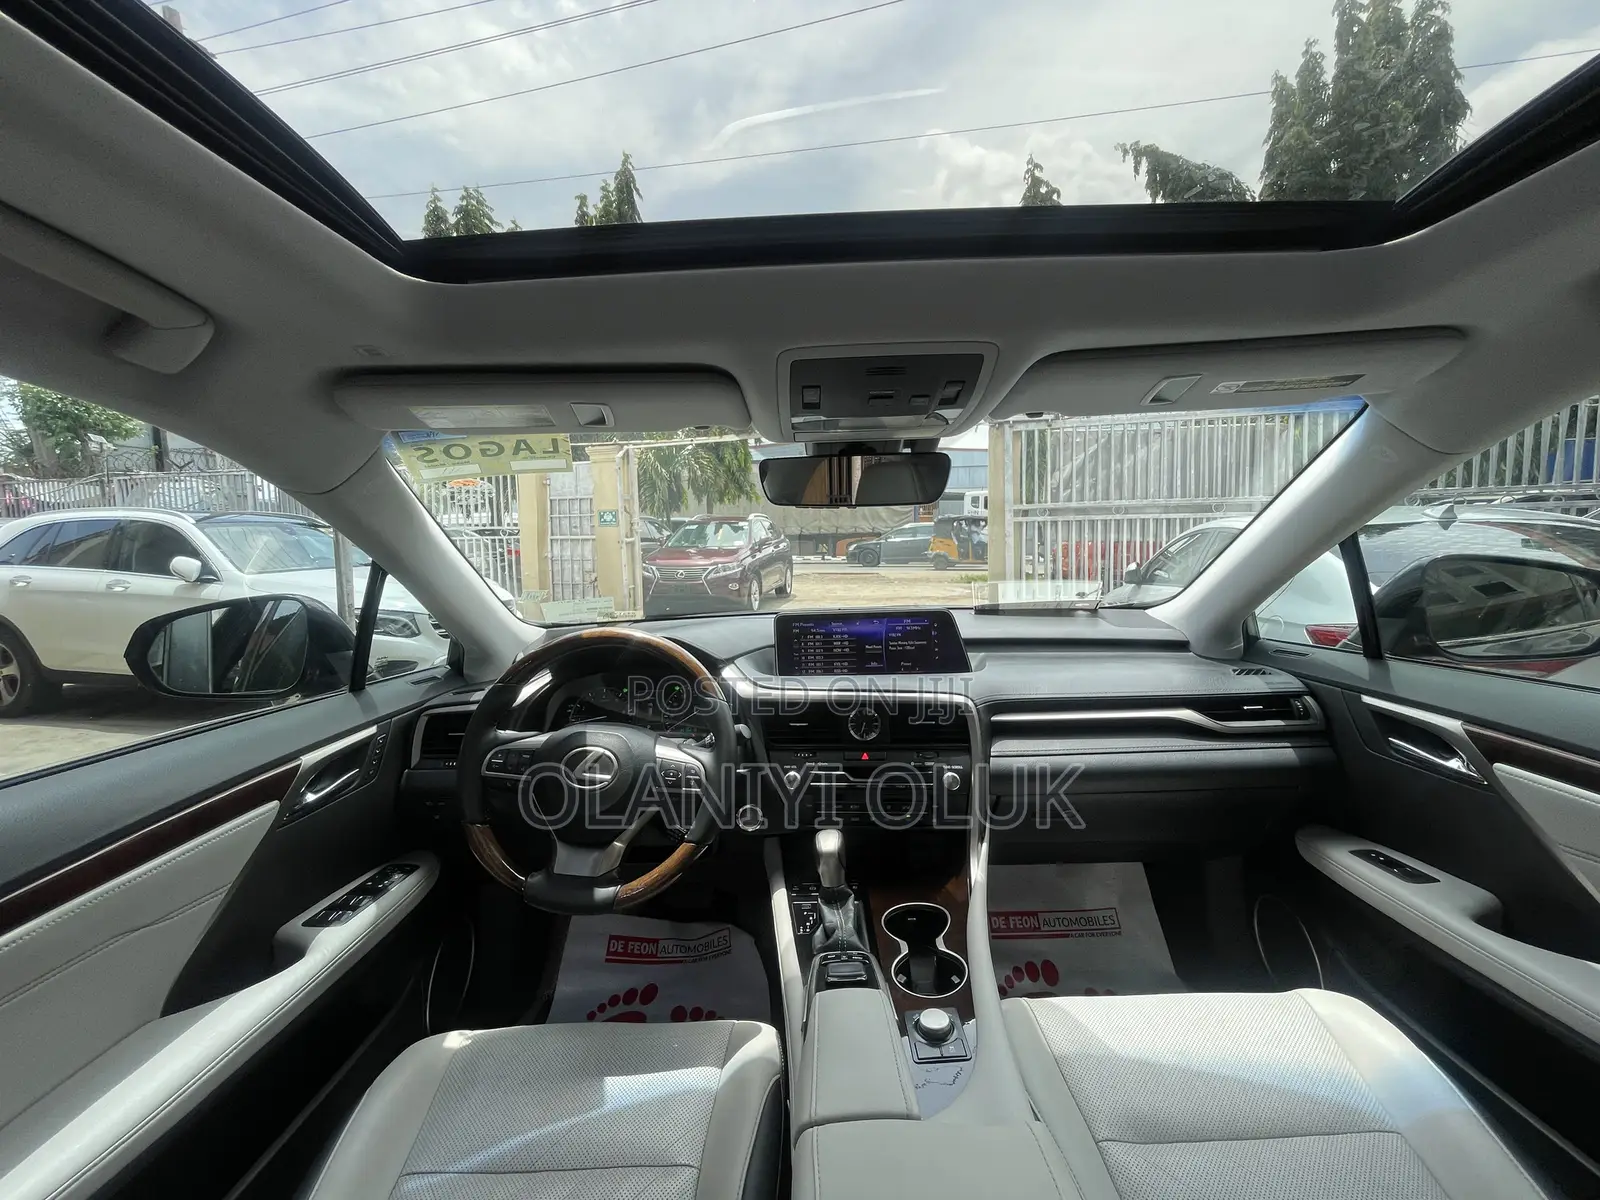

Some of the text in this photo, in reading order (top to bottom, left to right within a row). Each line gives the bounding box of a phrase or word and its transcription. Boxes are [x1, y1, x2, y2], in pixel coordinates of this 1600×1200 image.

[991, 914, 1116, 929] DE FEON AUTOMOBILES
[609, 935, 729, 955] DE FEON AUTOMOBILES
